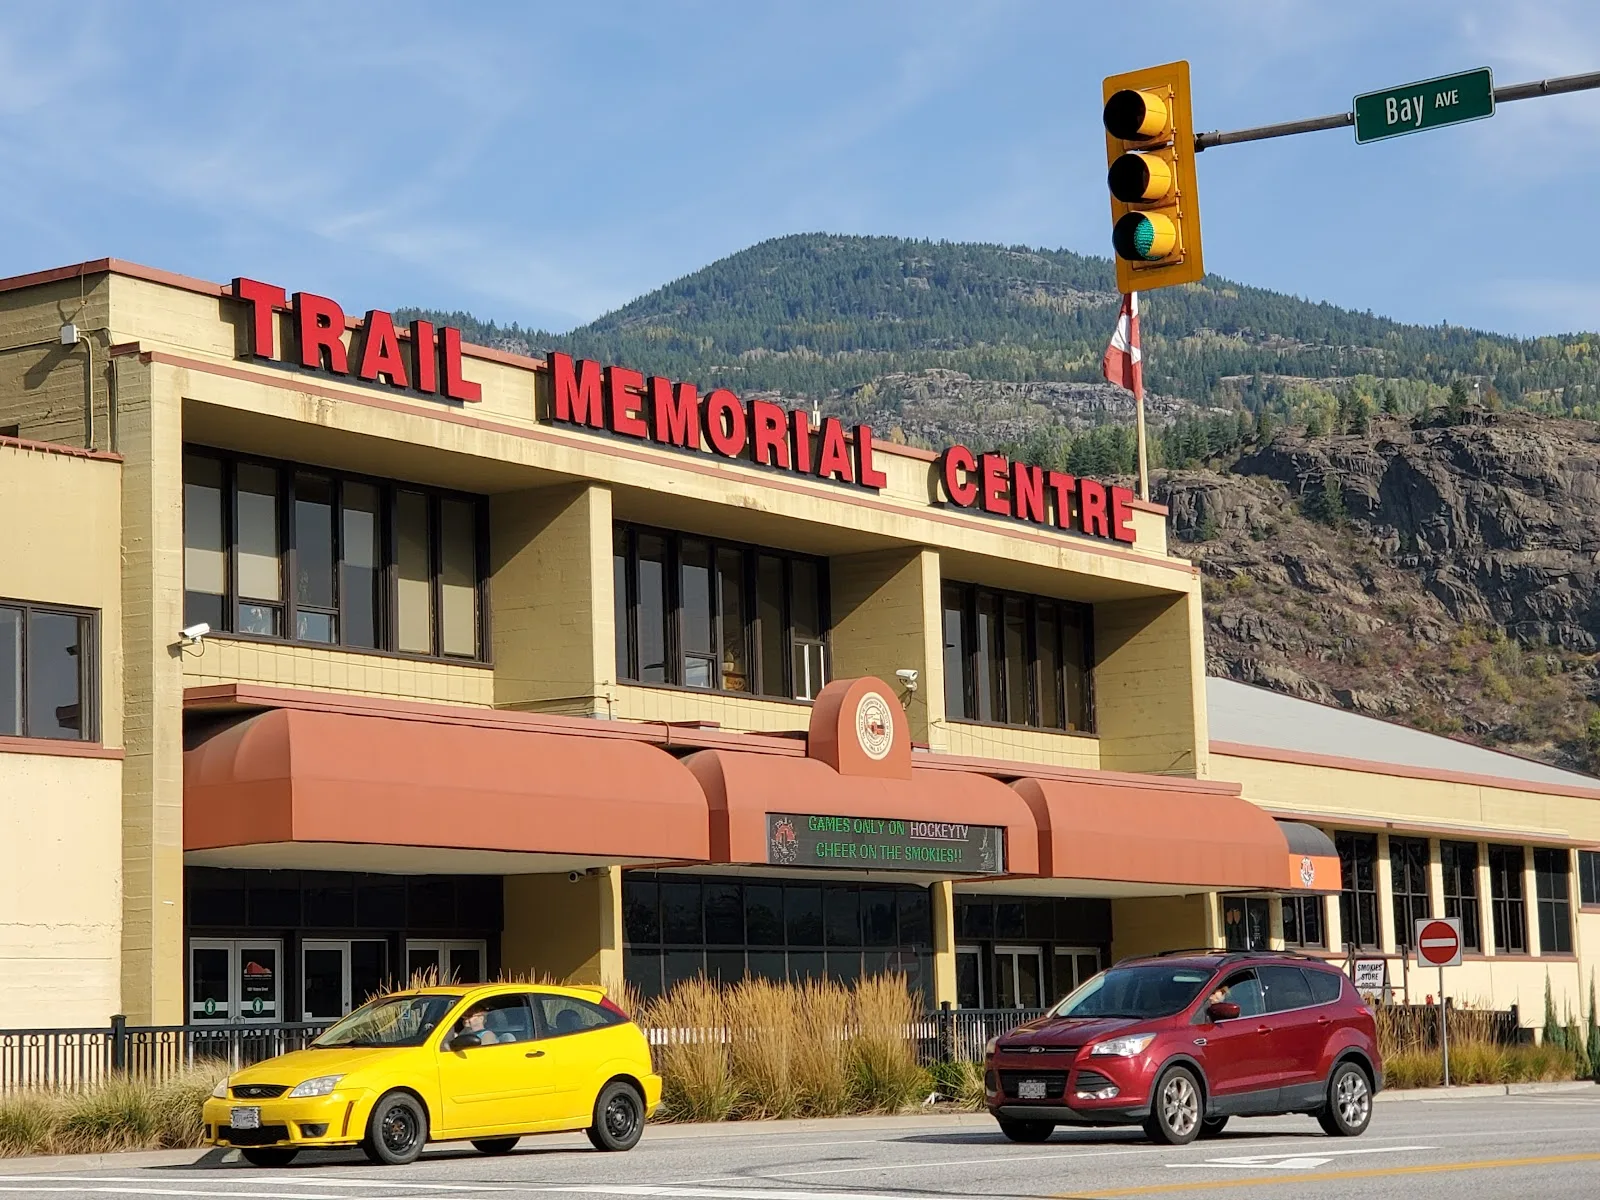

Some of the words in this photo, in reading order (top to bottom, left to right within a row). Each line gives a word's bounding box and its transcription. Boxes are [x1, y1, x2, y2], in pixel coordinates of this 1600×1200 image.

[1385, 95, 1424, 127] Bay
[1435, 89, 1459, 109] AVE
[232, 277, 482, 402] TRAIL
[547, 351, 887, 489] MEMORIAL
[941, 445, 1137, 543] CENTRE
[808, 815, 851, 833] GAMES
[853, 818, 885, 834] ONLY
[888, 820, 905, 835] ON
[910, 821, 969, 839] HOCKEYTV
[816, 842, 857, 859] CHEER
[860, 844, 877, 859] ON
[880, 845, 902, 860] THE
[905, 846, 962, 863] SMOKIES!!
[1357, 963, 1383, 972] SMOKIES
[1361, 973, 1379, 981] STORE
